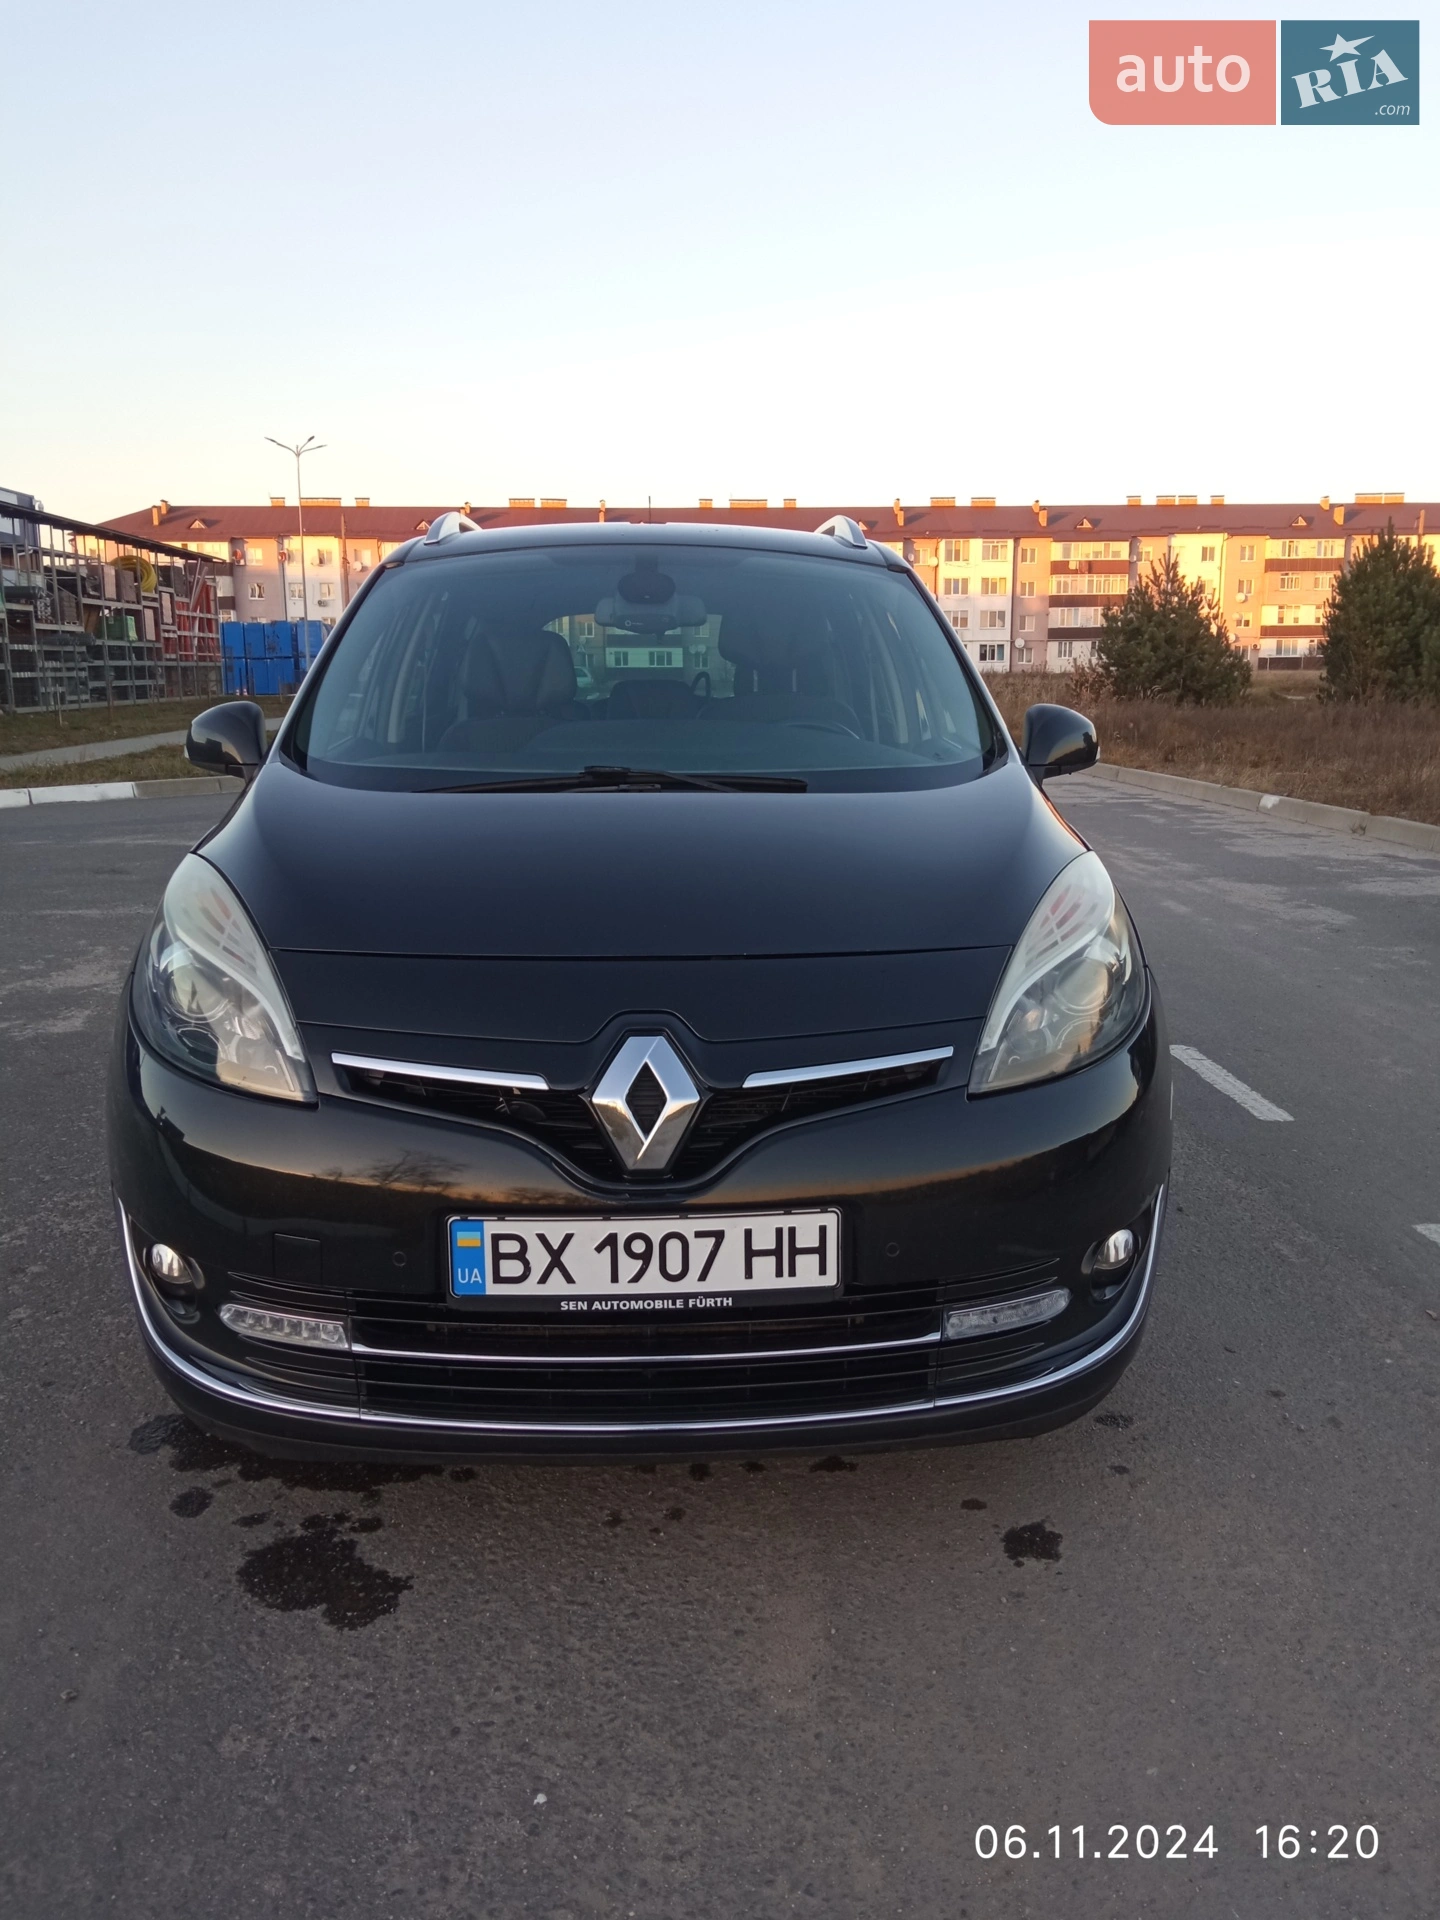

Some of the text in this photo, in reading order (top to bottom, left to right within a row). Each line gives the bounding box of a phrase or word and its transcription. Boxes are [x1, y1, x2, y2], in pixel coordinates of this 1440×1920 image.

[490, 1224, 828, 1285] BX 1907 HH
[457, 1267, 483, 1284] UA
[560, 1296, 733, 1311] SEN AUTOMOBILE FÜRTH
